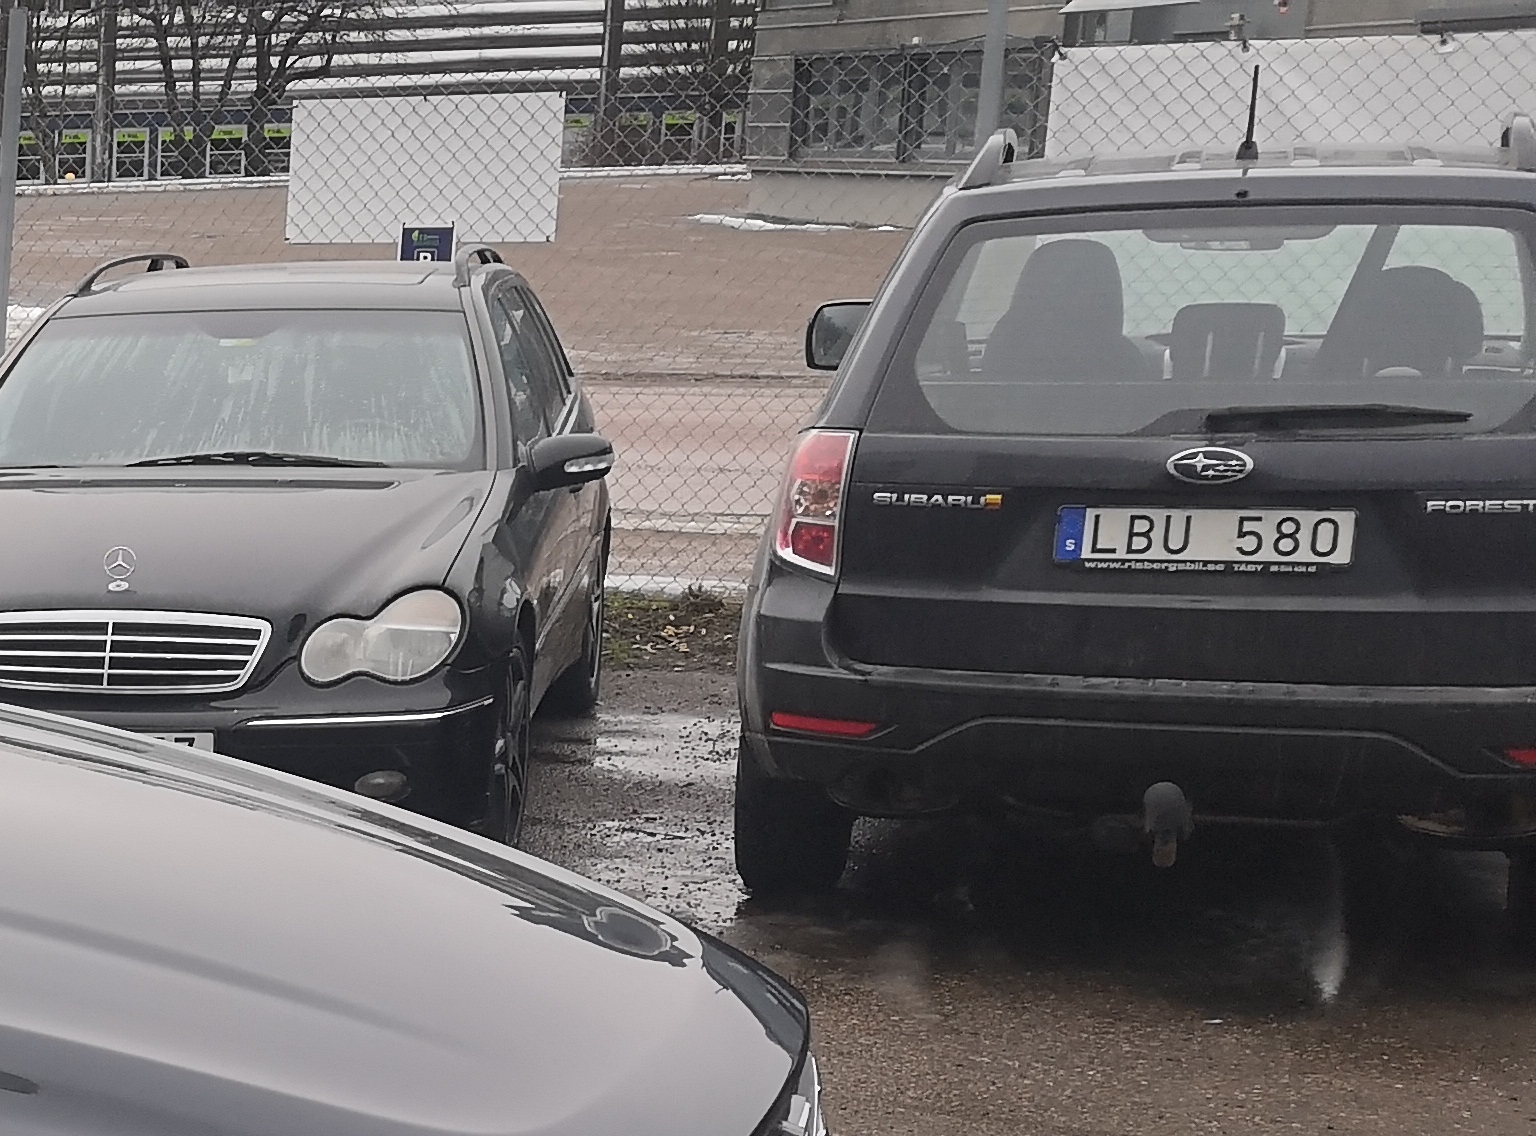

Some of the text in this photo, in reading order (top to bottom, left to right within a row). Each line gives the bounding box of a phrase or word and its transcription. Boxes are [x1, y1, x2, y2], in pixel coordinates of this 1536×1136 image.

[873, 492, 987, 508] SUBARU
[1426, 500, 1536, 513] FOREST
[1090, 514, 1339, 557] LBU 580
[1065, 539, 1075, 551] S
